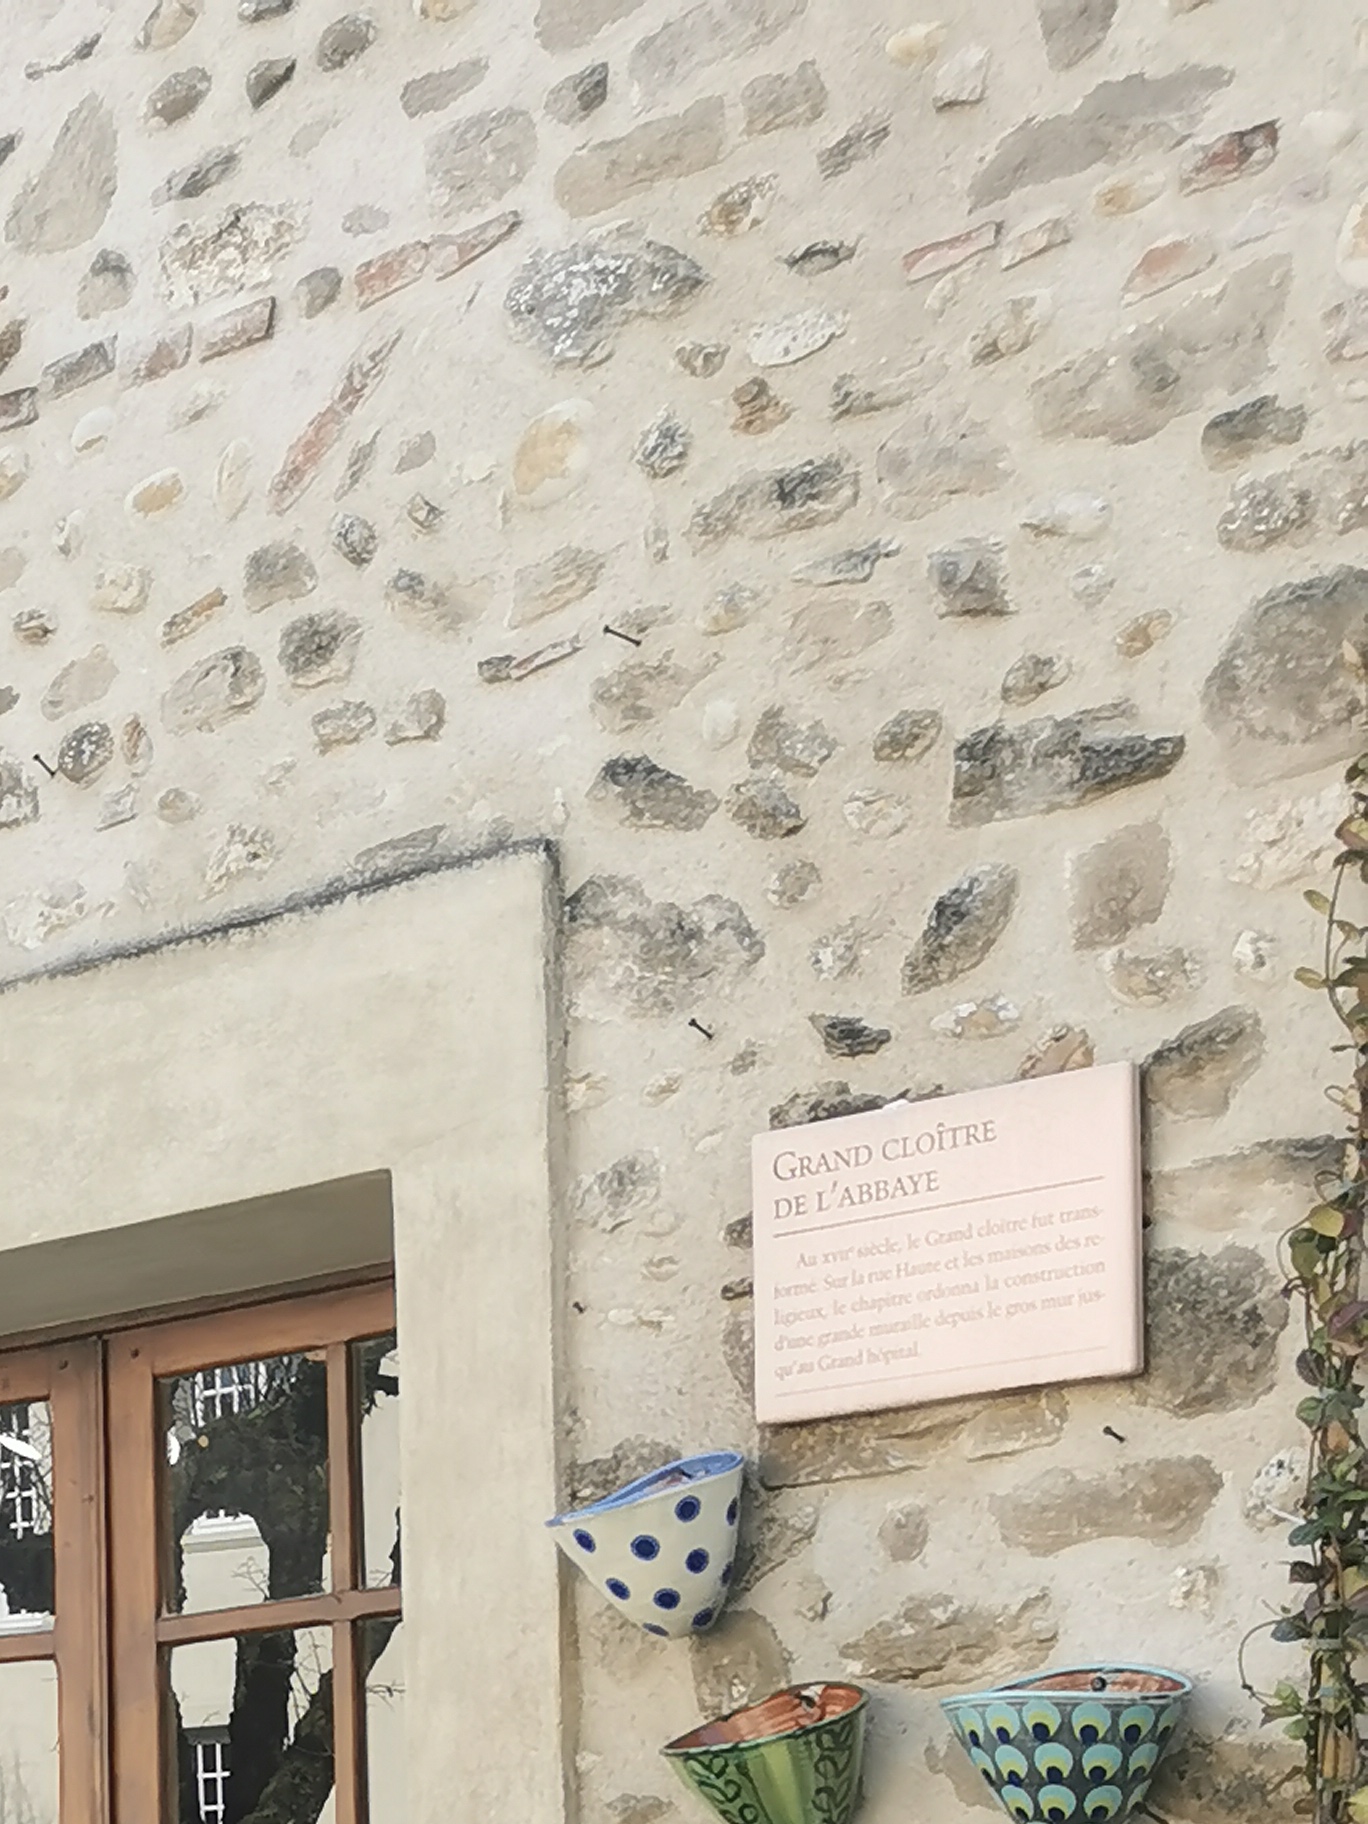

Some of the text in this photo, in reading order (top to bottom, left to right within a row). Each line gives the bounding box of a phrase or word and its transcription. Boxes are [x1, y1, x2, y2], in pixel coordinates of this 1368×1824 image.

[773, 1170, 941, 1220] DE L'ABBAYE
[796, 1252, 818, 1269] Au
[907, 1233, 921, 1250] le
[924, 1222, 973, 1247] Grand
[1031, 1211, 1054, 1229] fut
[1059, 1204, 1104, 1224] trans-
[823, 1273, 848, 1291] Sur
[851, 1269, 865, 1287] la
[868, 1269, 893, 1283] rue
[896, 1260, 941, 1279] Haute
[944, 1254, 960, 1271] et
[963, 1249, 984, 1268] les
[987, 1241, 1052, 1264] maisons
[1055, 1234, 1081, 1251] des
[1084, 1233, 1106, 1248] re-
[833, 1299, 847, 1315] le
[851, 1293, 912, 1314] chapitre
[917, 1280, 979, 1301] ordonna
[984, 1274, 999, 1291] la
[1004, 1260, 1105, 1289] construction
[817, 1323, 865, 1348] grande
[869, 1312, 931, 1337] muraille
[934, 1306, 984, 1328] depuis
[987, 1300, 1003, 1319] le
[1005, 1298, 1038, 1317] gros
[1040, 1293, 1074, 1311] mur
[1078, 1287, 1106, 1307] jus-
[818, 1348, 863, 1371] Grand
